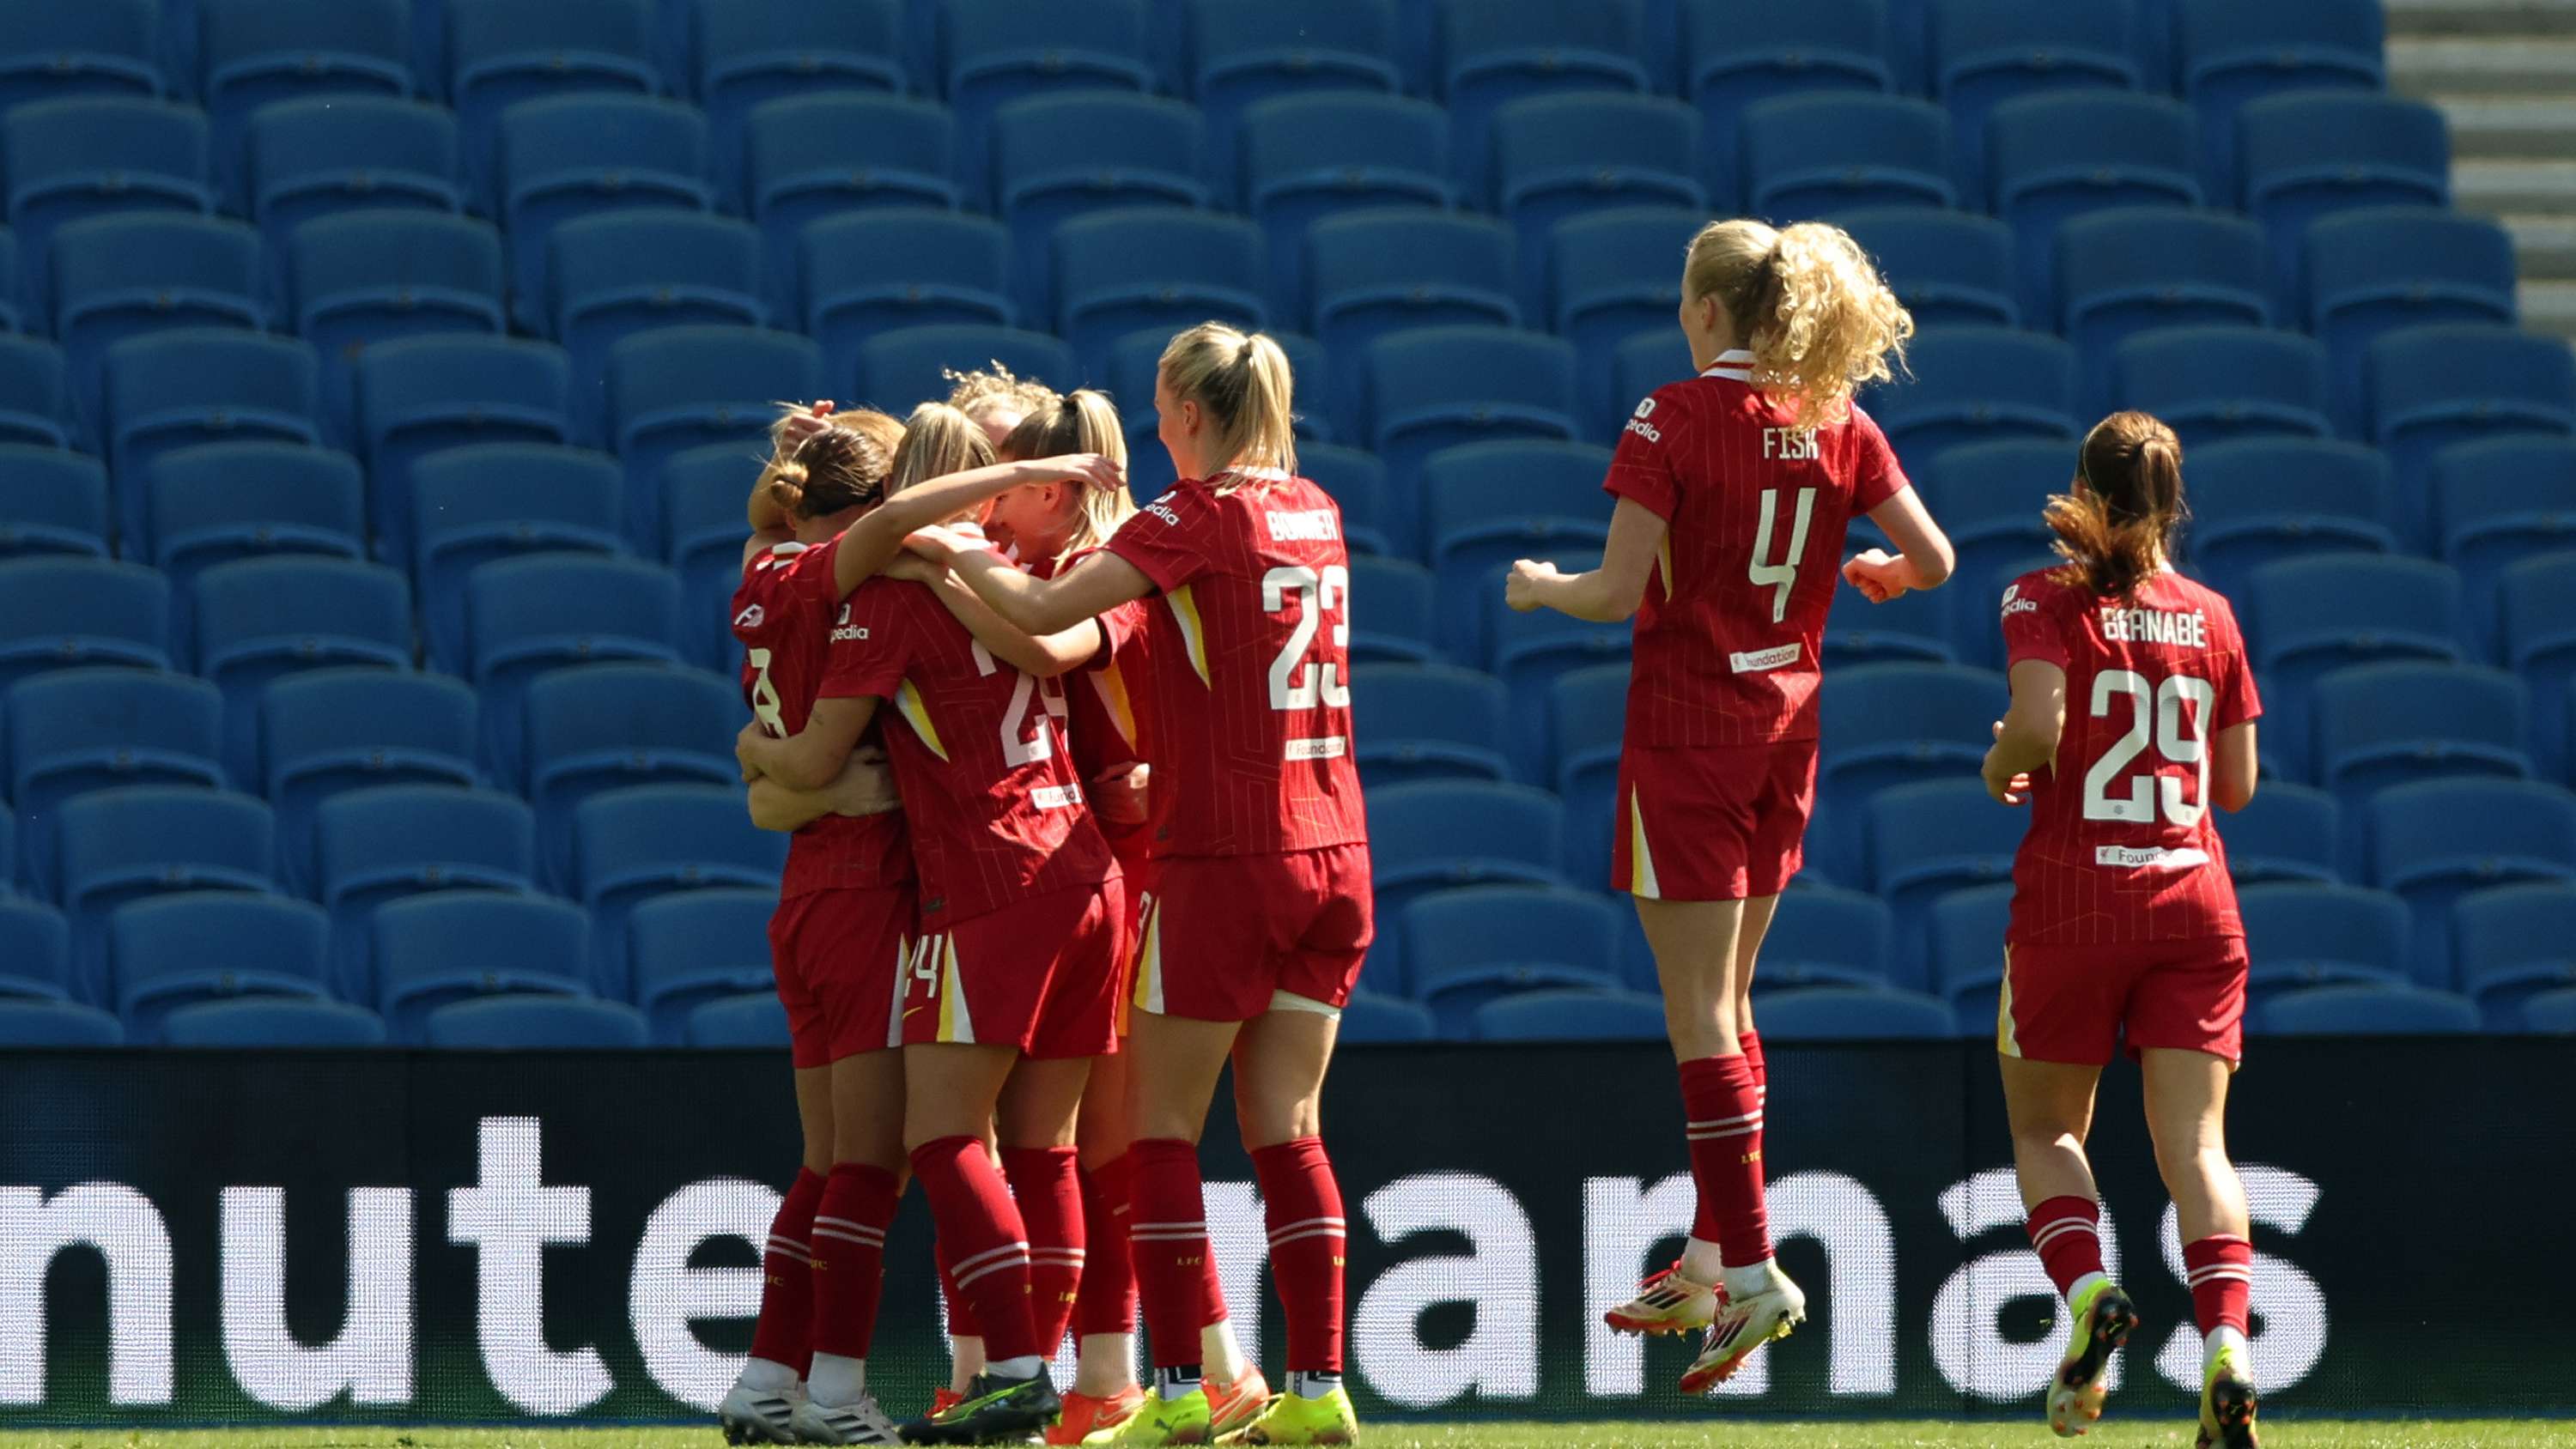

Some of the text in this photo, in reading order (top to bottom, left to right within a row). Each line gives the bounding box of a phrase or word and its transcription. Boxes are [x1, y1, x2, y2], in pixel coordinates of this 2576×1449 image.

[1763, 427, 1819, 459] FISK
[1748, 488, 1817, 624] 4
[1262, 566, 1351, 711] 23
[2100, 607, 2207, 649] BERNABÉ
[2083, 669, 2215, 828] 29
